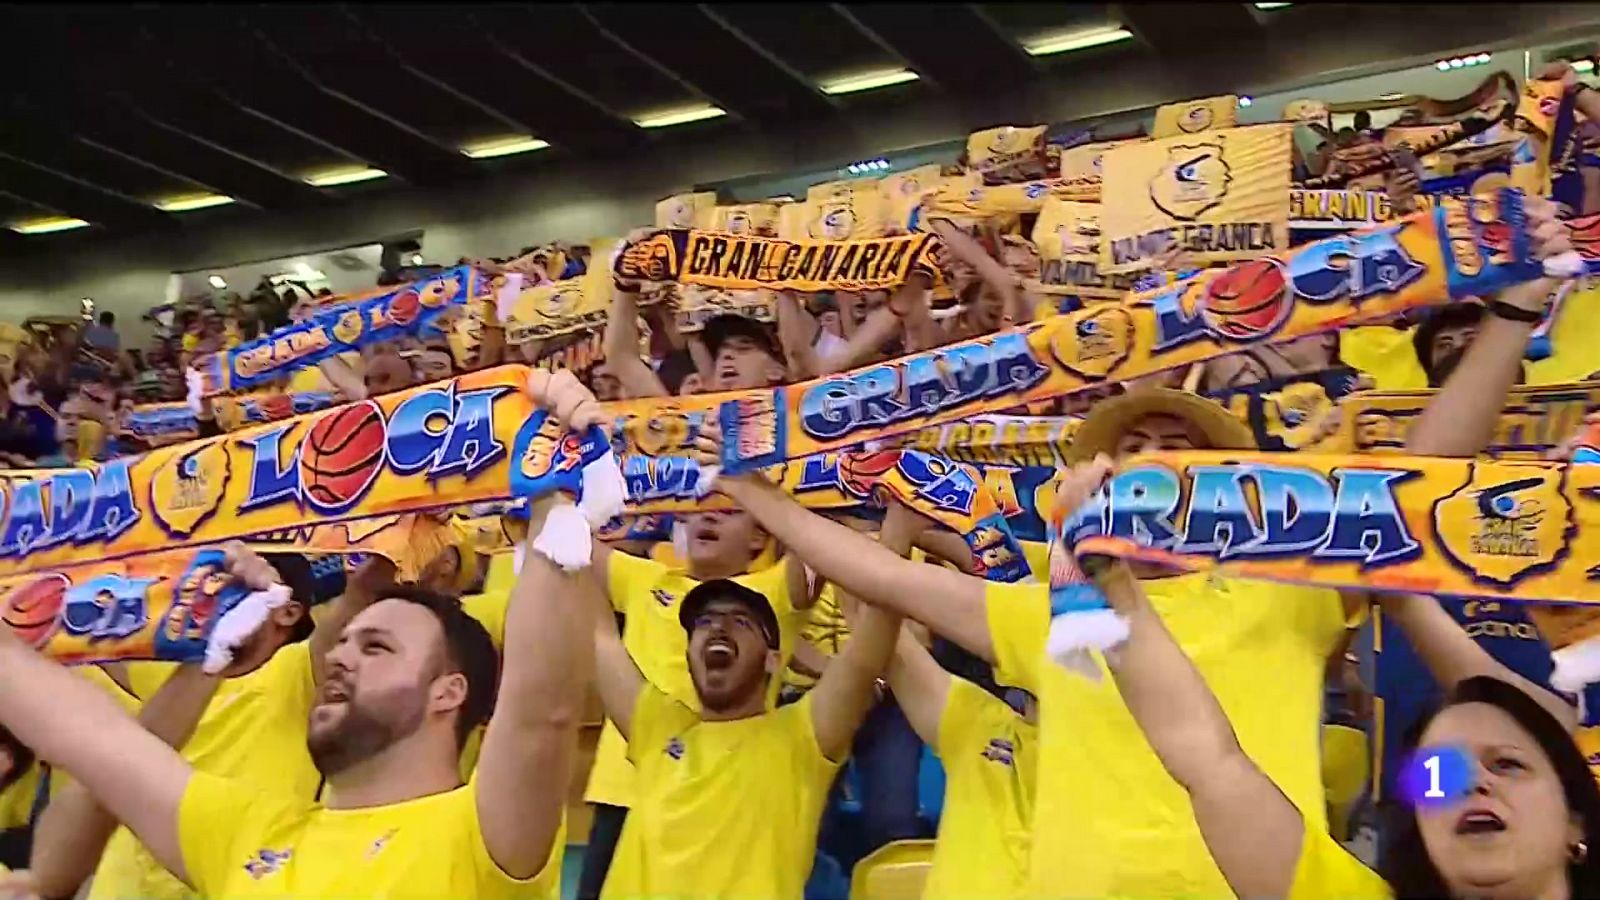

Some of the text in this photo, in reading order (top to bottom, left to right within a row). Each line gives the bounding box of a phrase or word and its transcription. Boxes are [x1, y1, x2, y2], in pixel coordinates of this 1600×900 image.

[690, 236, 914, 282] GRAN CANARIA
[802, 330, 1052, 442] GRADA
[1148, 223, 1426, 350] LOCA
[0, 455, 142, 561] ADA
[236, 376, 518, 518] LOCA
